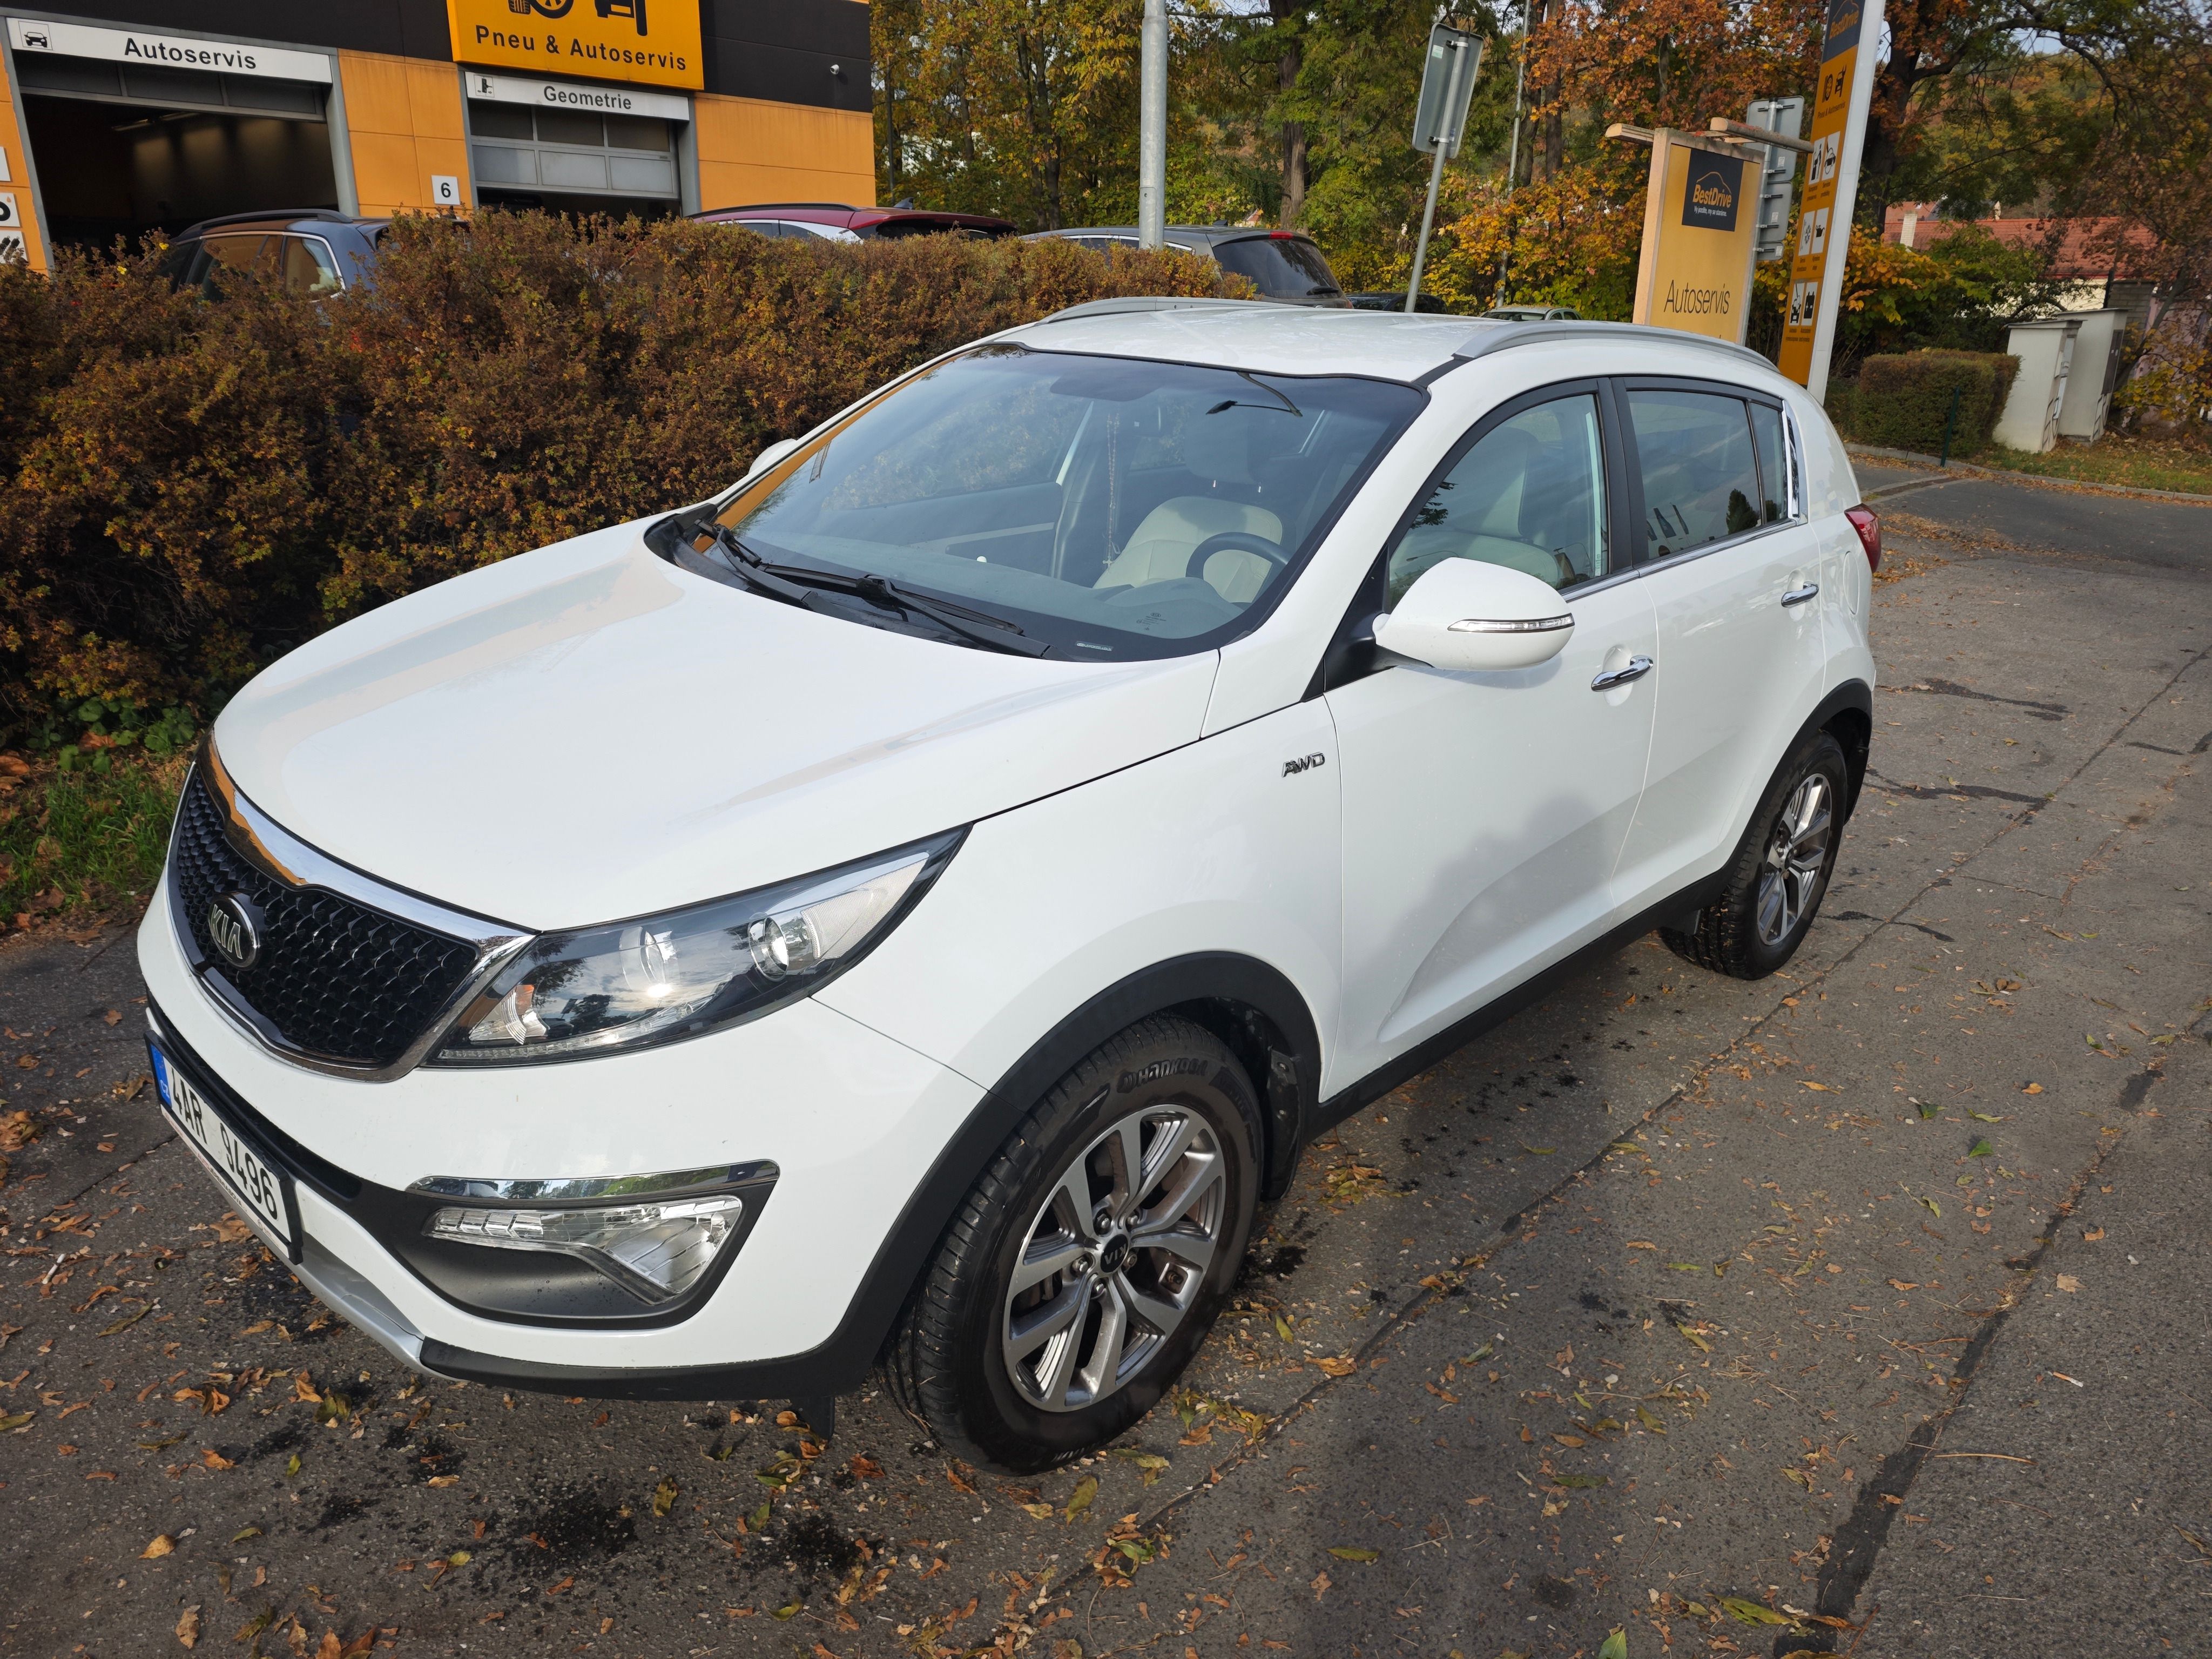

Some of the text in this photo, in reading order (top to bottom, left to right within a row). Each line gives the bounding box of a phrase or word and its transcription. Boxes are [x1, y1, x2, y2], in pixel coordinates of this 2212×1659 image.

[124, 37, 257, 69] Autoservis
[476, 25, 686, 71] Pneu & Autoservis
[543, 85, 632, 110] Geometrie
[441, 182, 451, 198] 6
[1692, 184, 1732, 208] BestDrive
[1663, 279, 1730, 314] Autoservis
[1282, 752, 1325, 778] AWD
[211, 903, 243, 960] KIA
[160, 1080, 170, 1099] CZ
[171, 1067, 208, 1145] 4AR
[220, 1122, 278, 1220] 9496
[1104, 1243, 1127, 1265] KIA
